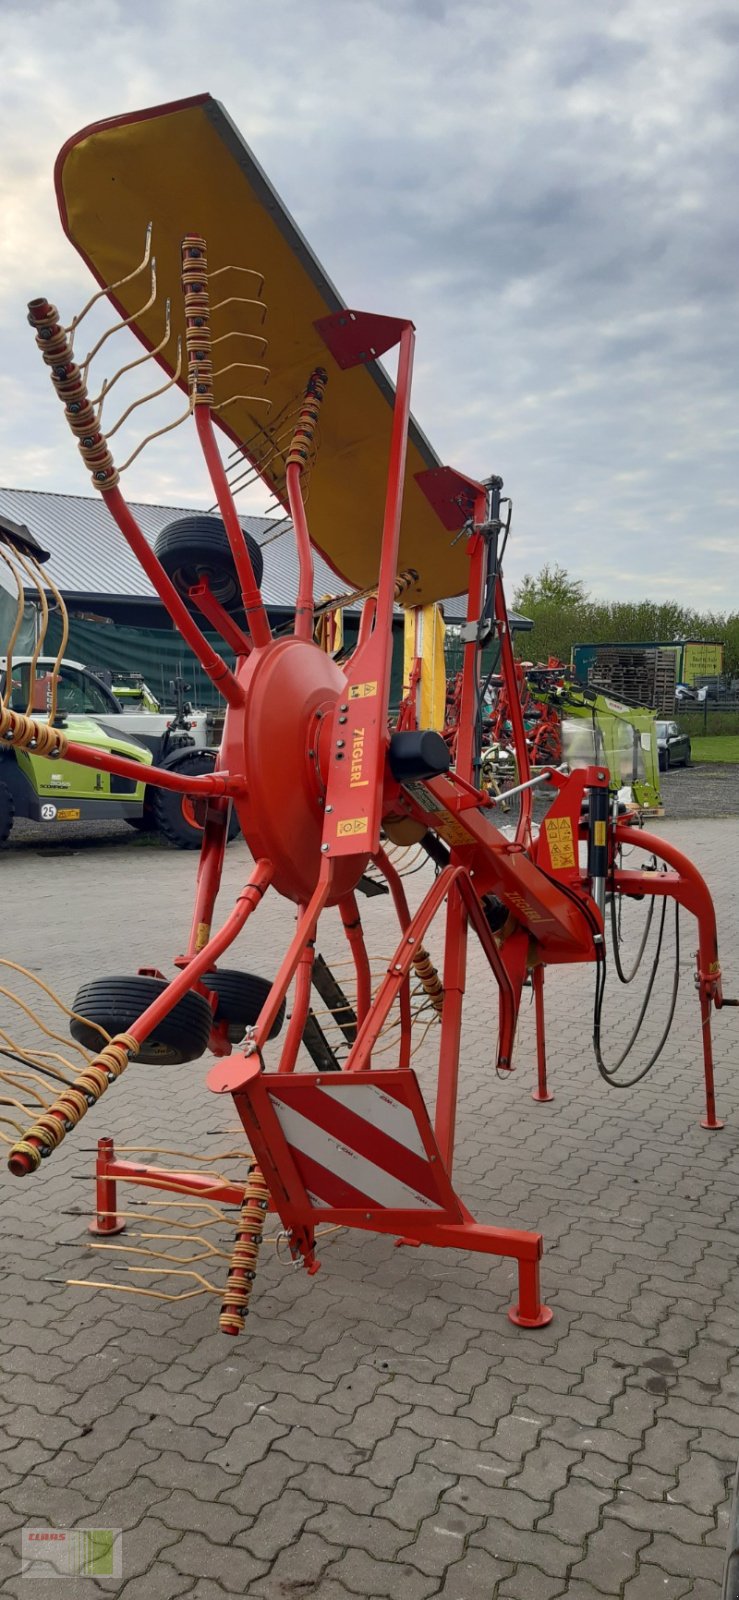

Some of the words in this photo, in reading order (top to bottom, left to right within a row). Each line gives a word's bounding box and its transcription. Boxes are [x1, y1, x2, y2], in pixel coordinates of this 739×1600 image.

[349, 727, 366, 783] ZIEGLER
[43, 806, 54, 818] 25
[504, 891, 542, 921] ZIEGLER
